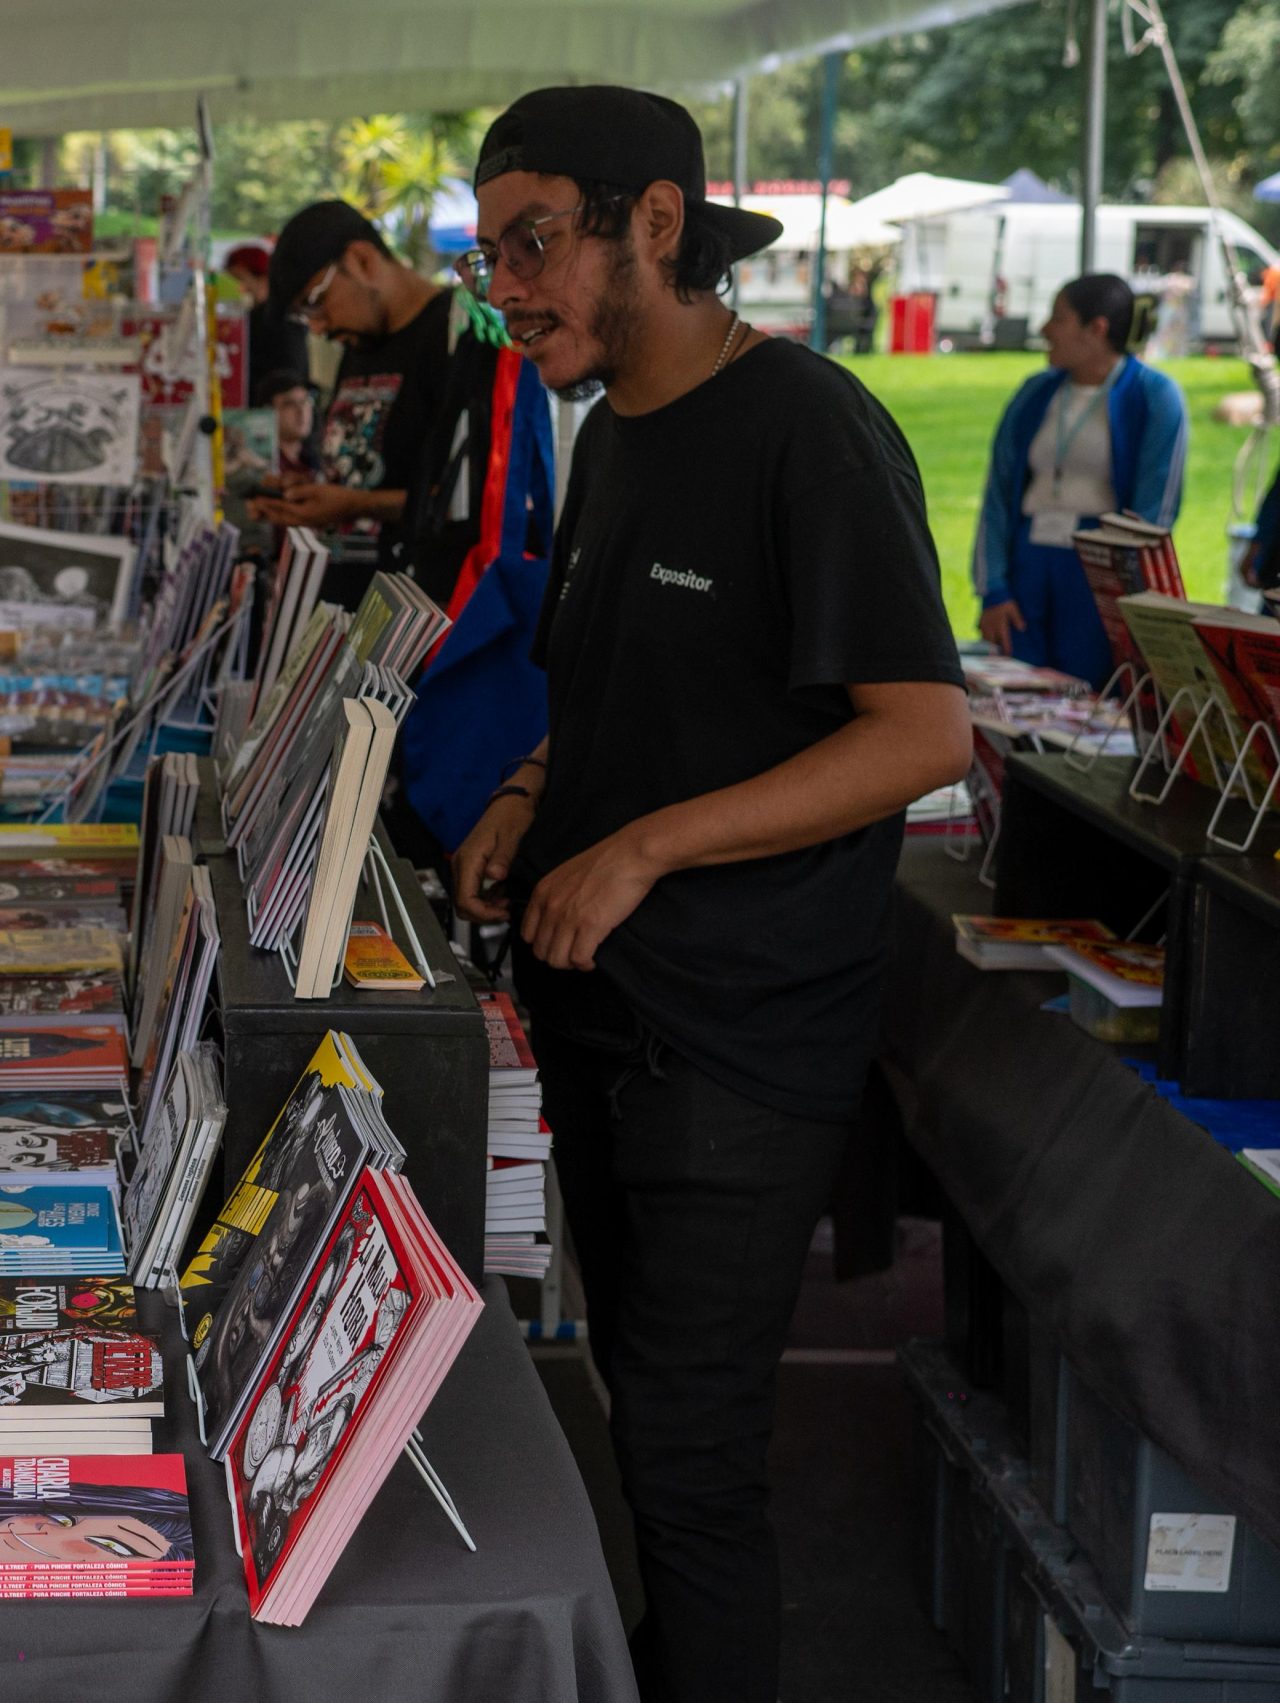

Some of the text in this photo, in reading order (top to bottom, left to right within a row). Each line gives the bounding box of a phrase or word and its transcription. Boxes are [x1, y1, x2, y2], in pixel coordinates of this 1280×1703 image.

[650, 563, 713, 592] Expositor
[358, 1226, 391, 1305] LA MALA
[339, 1271, 368, 1351] HORA
[13, 1457, 37, 1499] TRANQUILA
[37, 1457, 70, 1499] CHARLA
[103, 1581, 126, 1589] CÓMICS
[104, 1589, 127, 1597] CÓMICS
